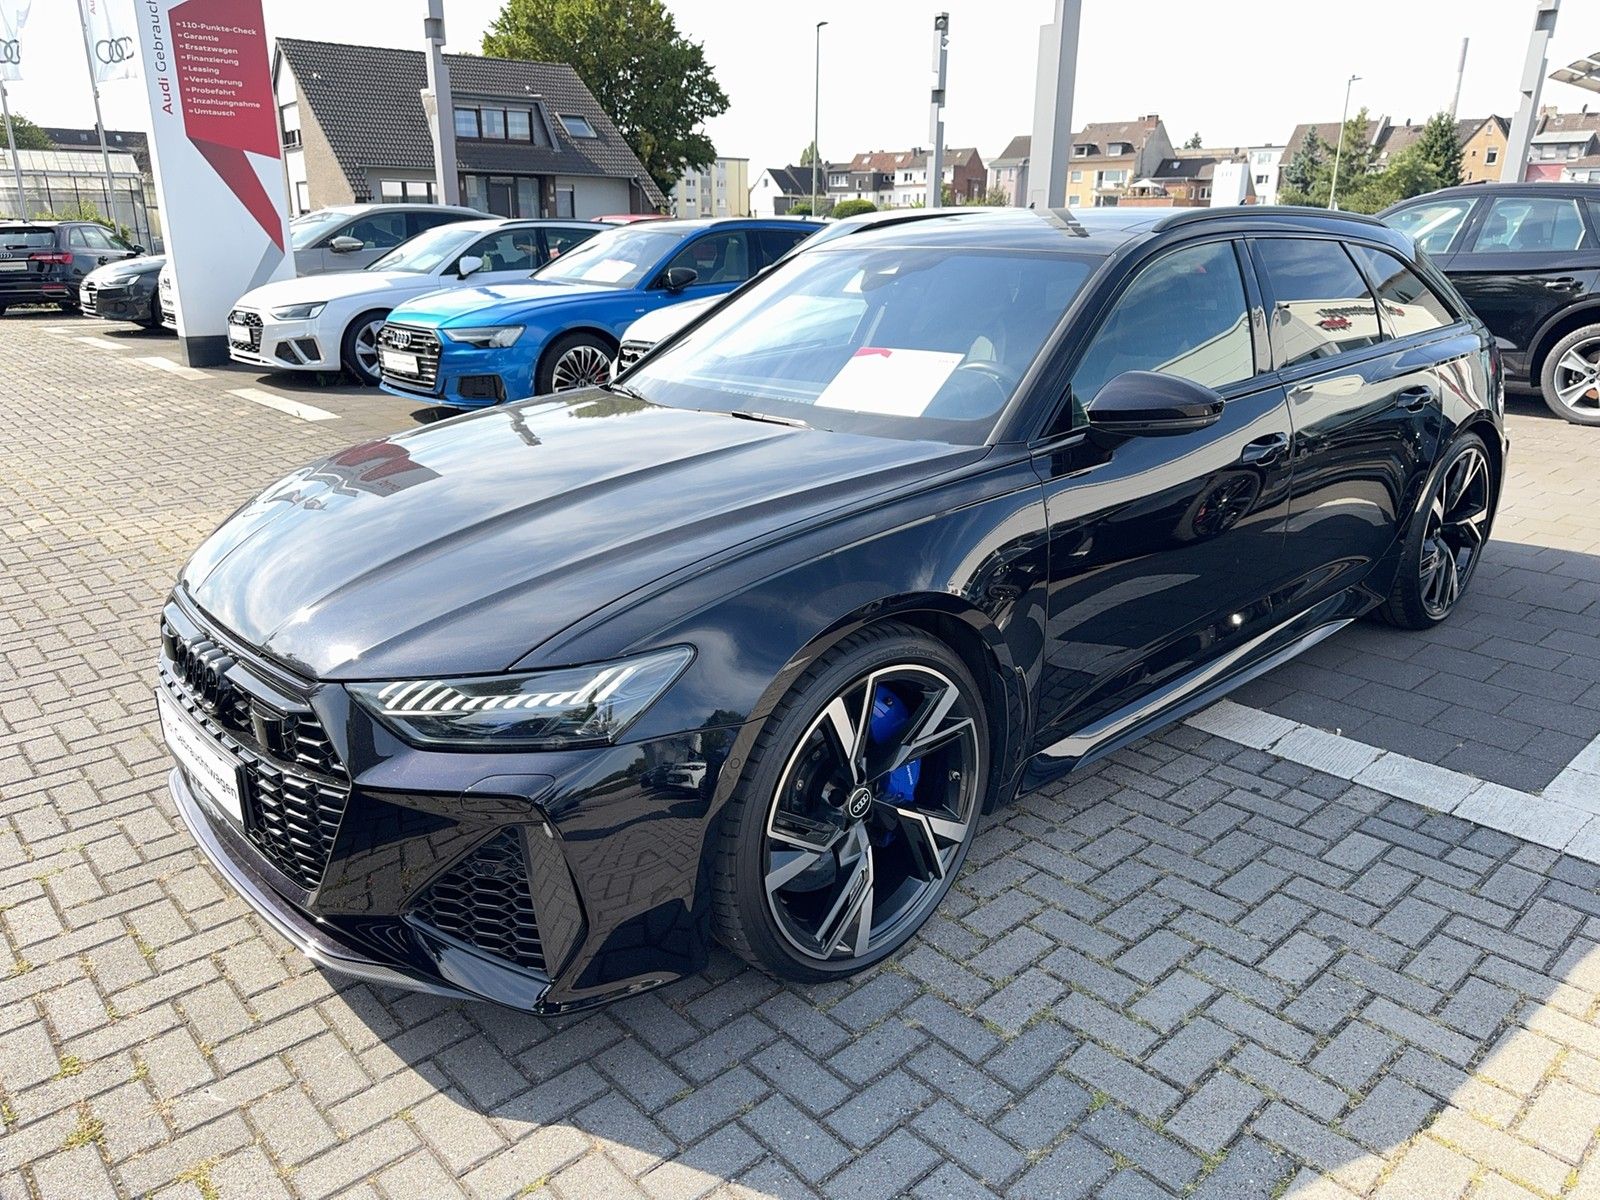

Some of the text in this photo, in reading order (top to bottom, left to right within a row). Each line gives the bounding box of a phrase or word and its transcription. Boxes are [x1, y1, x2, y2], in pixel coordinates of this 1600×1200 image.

[182, 21, 257, 35] 110-Punkte-Check
[183, 32, 219, 41] Garantie
[185, 43, 238, 54] Ersatzwagen
[186, 54, 239, 66] Finanzierung
[188, 65, 220, 75] Leasing
[189, 76, 243, 87] Versicherung
[158, 77, 173, 115] Audi
[191, 87, 236, 96] Probefahrt
[193, 97, 260, 108] Inzahlungnahme
[194, 108, 236, 116] Umtausch
